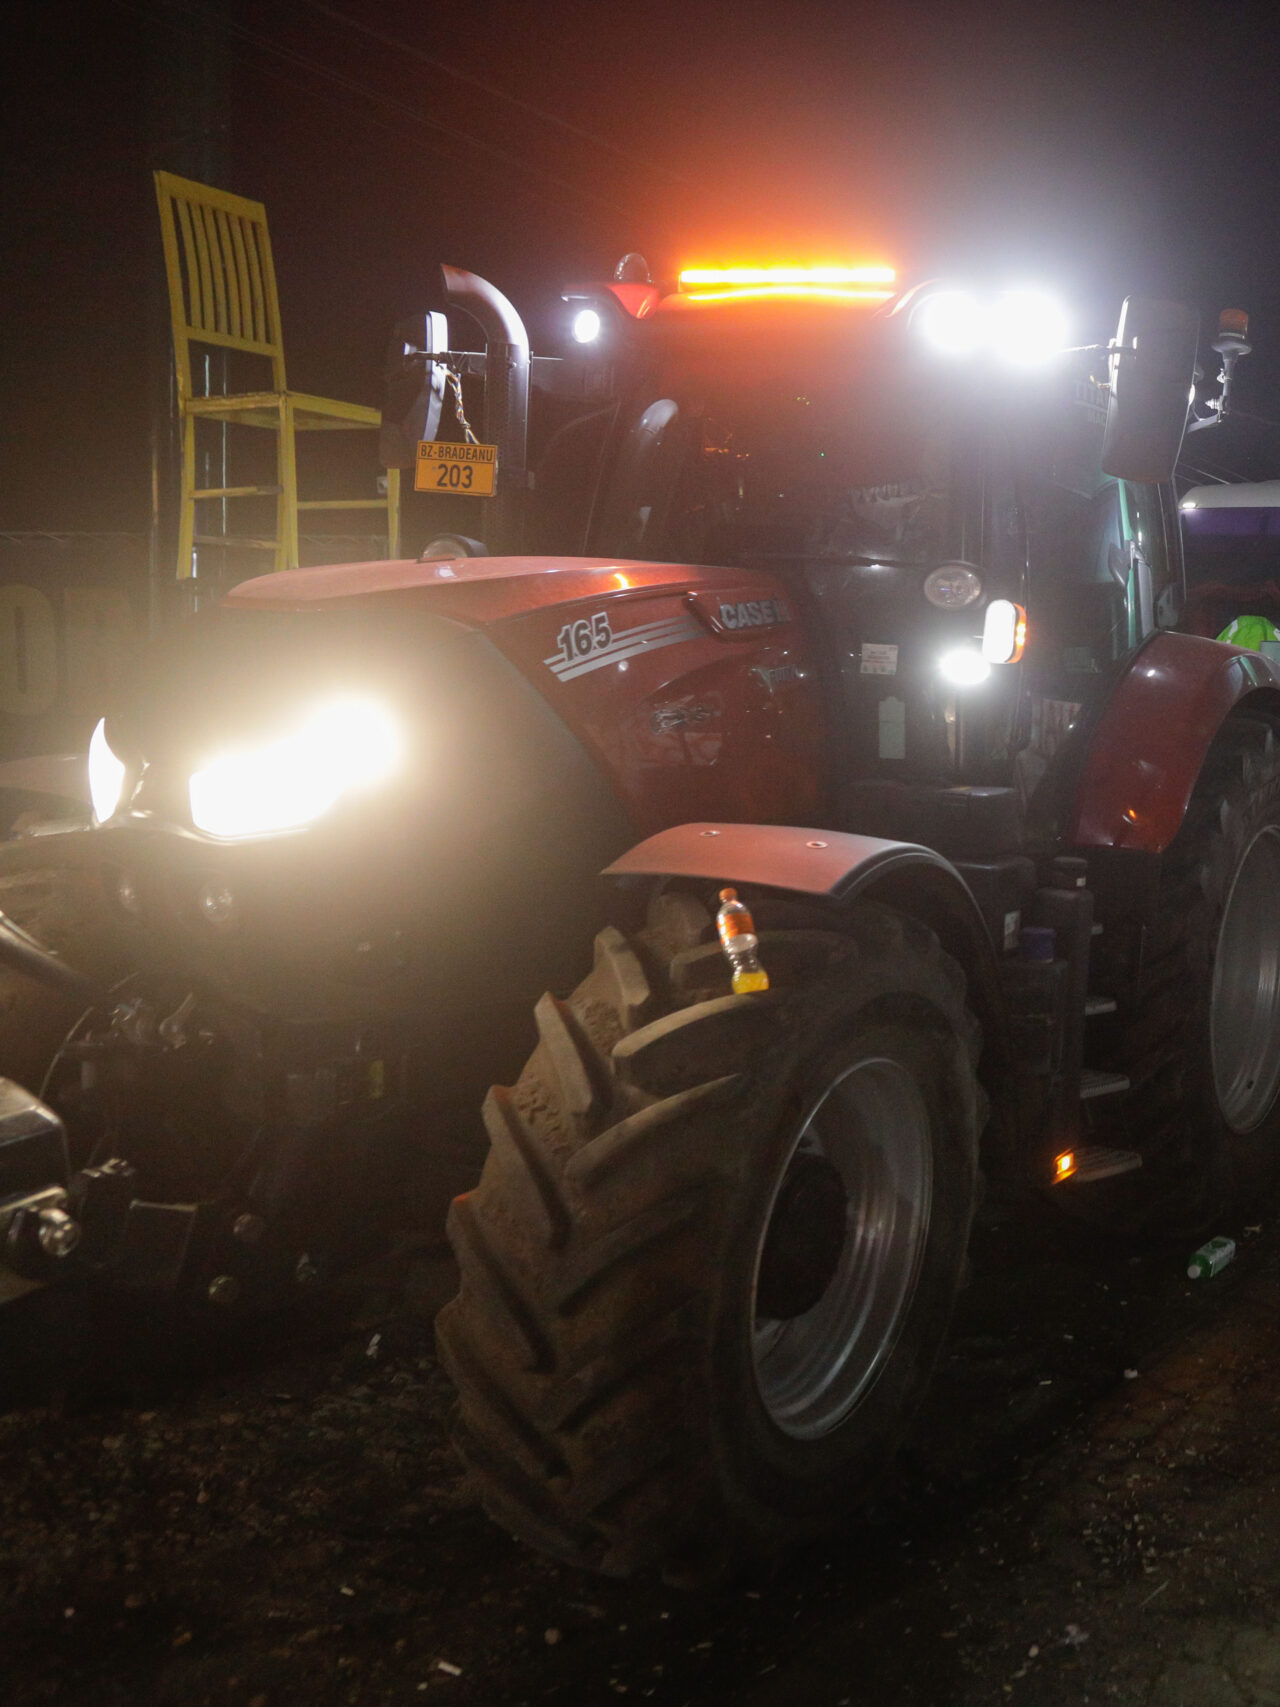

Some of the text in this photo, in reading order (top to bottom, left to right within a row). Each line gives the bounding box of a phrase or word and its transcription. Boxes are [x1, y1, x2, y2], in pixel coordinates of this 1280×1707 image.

[420, 445, 493, 461] BZ-BRADEANU
[436, 463, 473, 489] 203
[719, 601, 775, 629] CASE
[557, 611, 613, 662] 165
